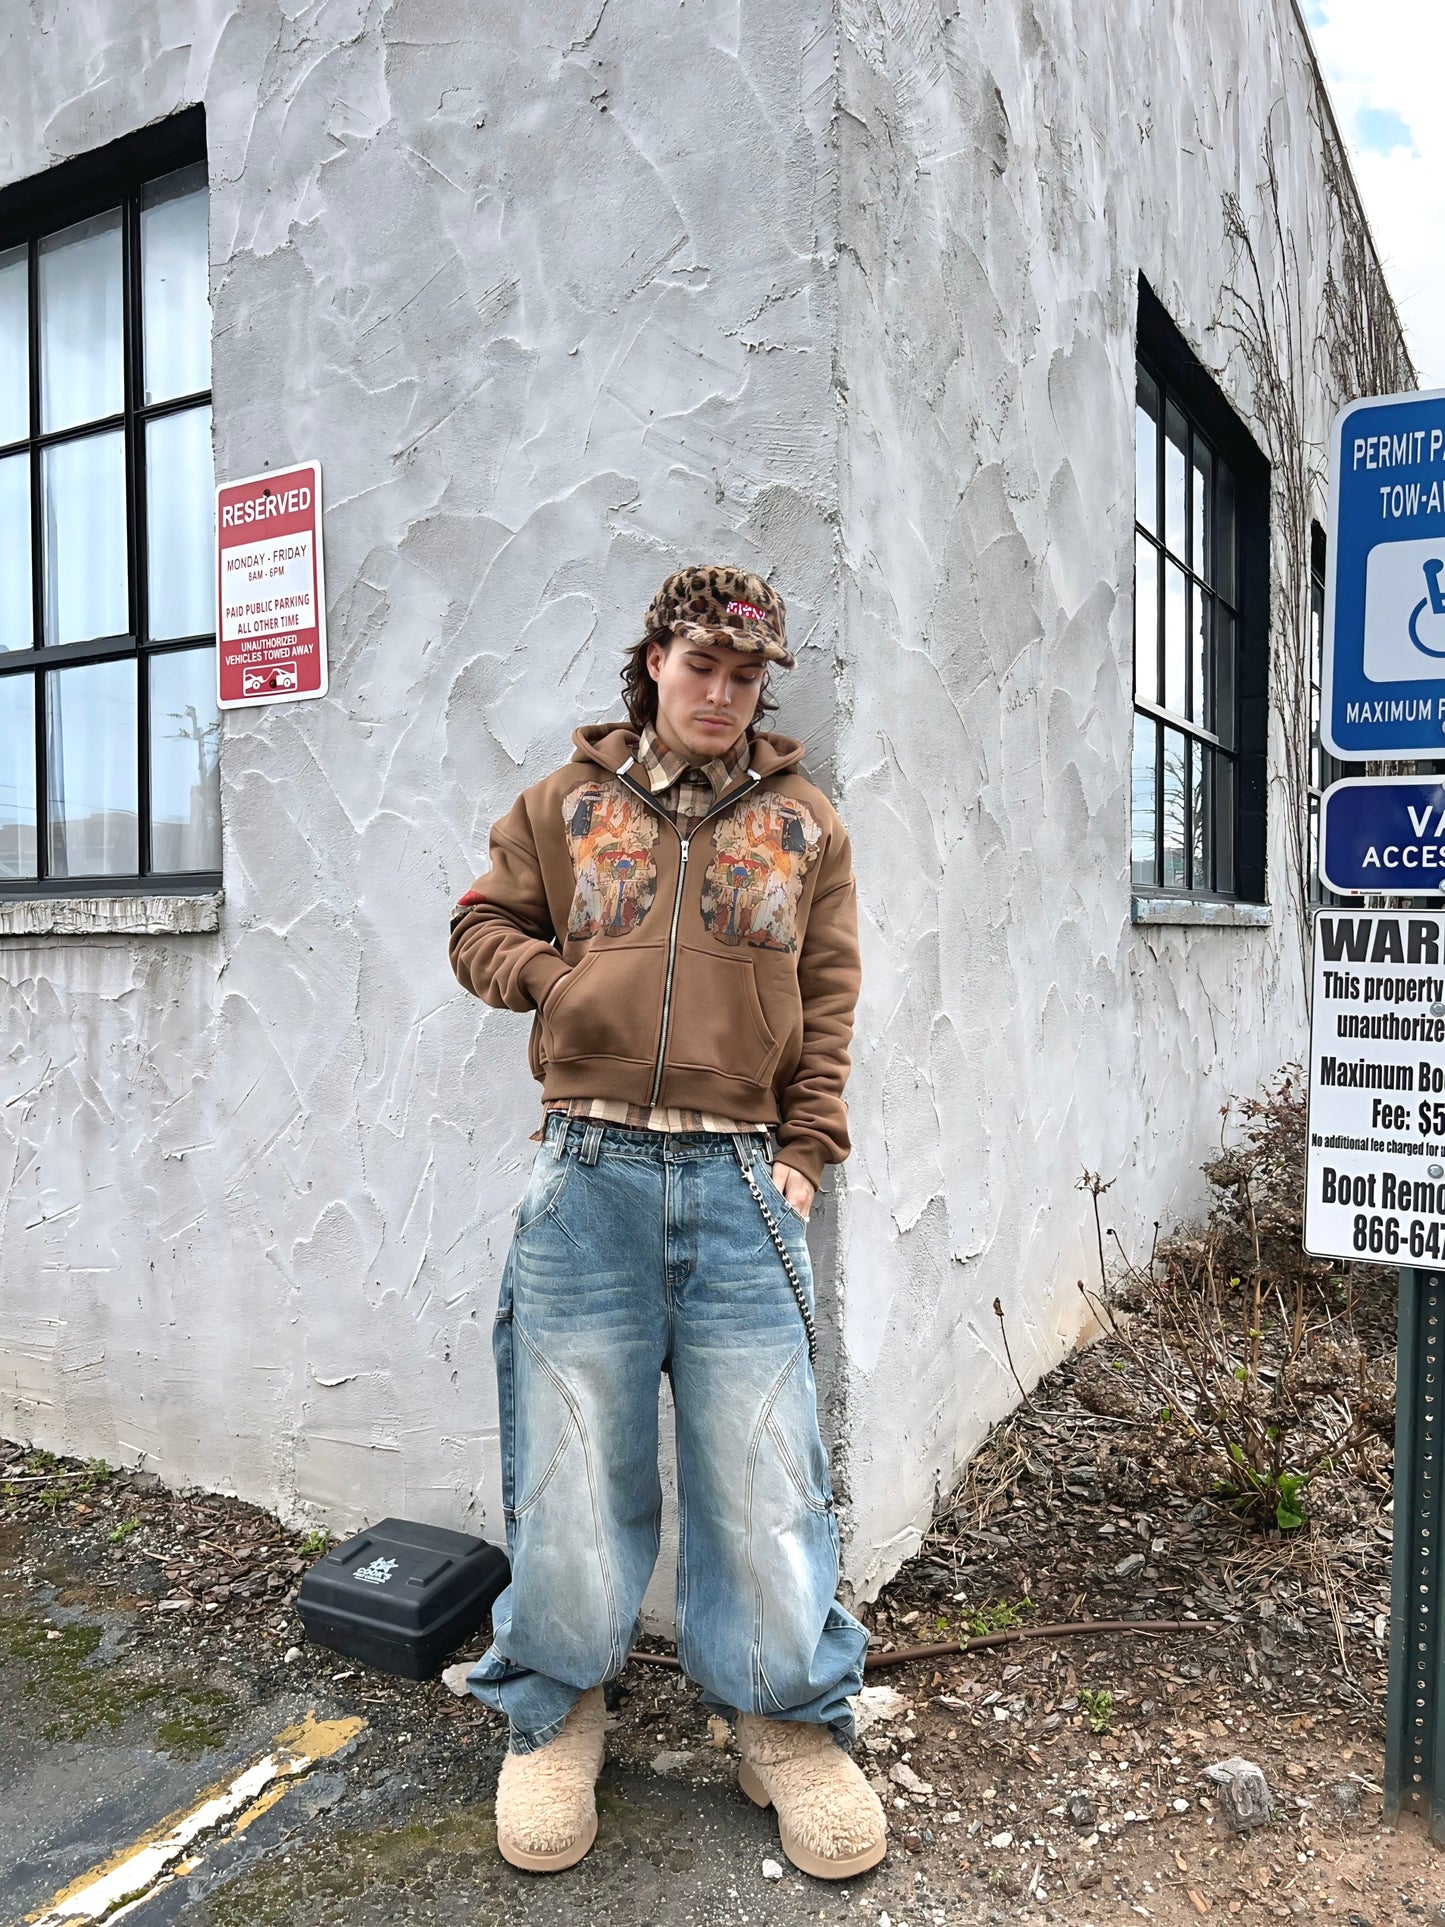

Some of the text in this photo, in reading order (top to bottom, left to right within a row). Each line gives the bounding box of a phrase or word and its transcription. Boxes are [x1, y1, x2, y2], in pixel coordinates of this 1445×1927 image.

[1353, 429, 1445, 471] PERMIT P
[222, 487, 311, 528] RESERVED
[1380, 480, 1445, 519] TOW-A
[227, 553, 265, 572] MONDAY
[273, 545, 307, 563] FRIDAY
[248, 570, 263, 582] 8AM
[269, 566, 285, 578] 6PM
[226, 593, 310, 619] PAID PUBLIC PARKING
[237, 613, 299, 635] ALL OTHER TIME
[225, 643, 314, 666] VEHICLES TOWED AWAY
[241, 634, 297, 652] UNAUTHORIZED
[1346, 699, 1432, 724] MAXIMUM
[1319, 918, 1445, 965] WAR
[1323, 971, 1444, 1005] This property
[1320, 1056, 1445, 1093] Maximum Bo
[1372, 1098, 1411, 1131] Fee:
[1311, 1133, 1323, 1147] No
[1324, 1135, 1369, 1152] additional
[1370, 1138, 1385, 1153] fee
[1386, 1140, 1424, 1157] charged
[1425, 1142, 1439, 1157] for
[1322, 1167, 1376, 1208] Boot
